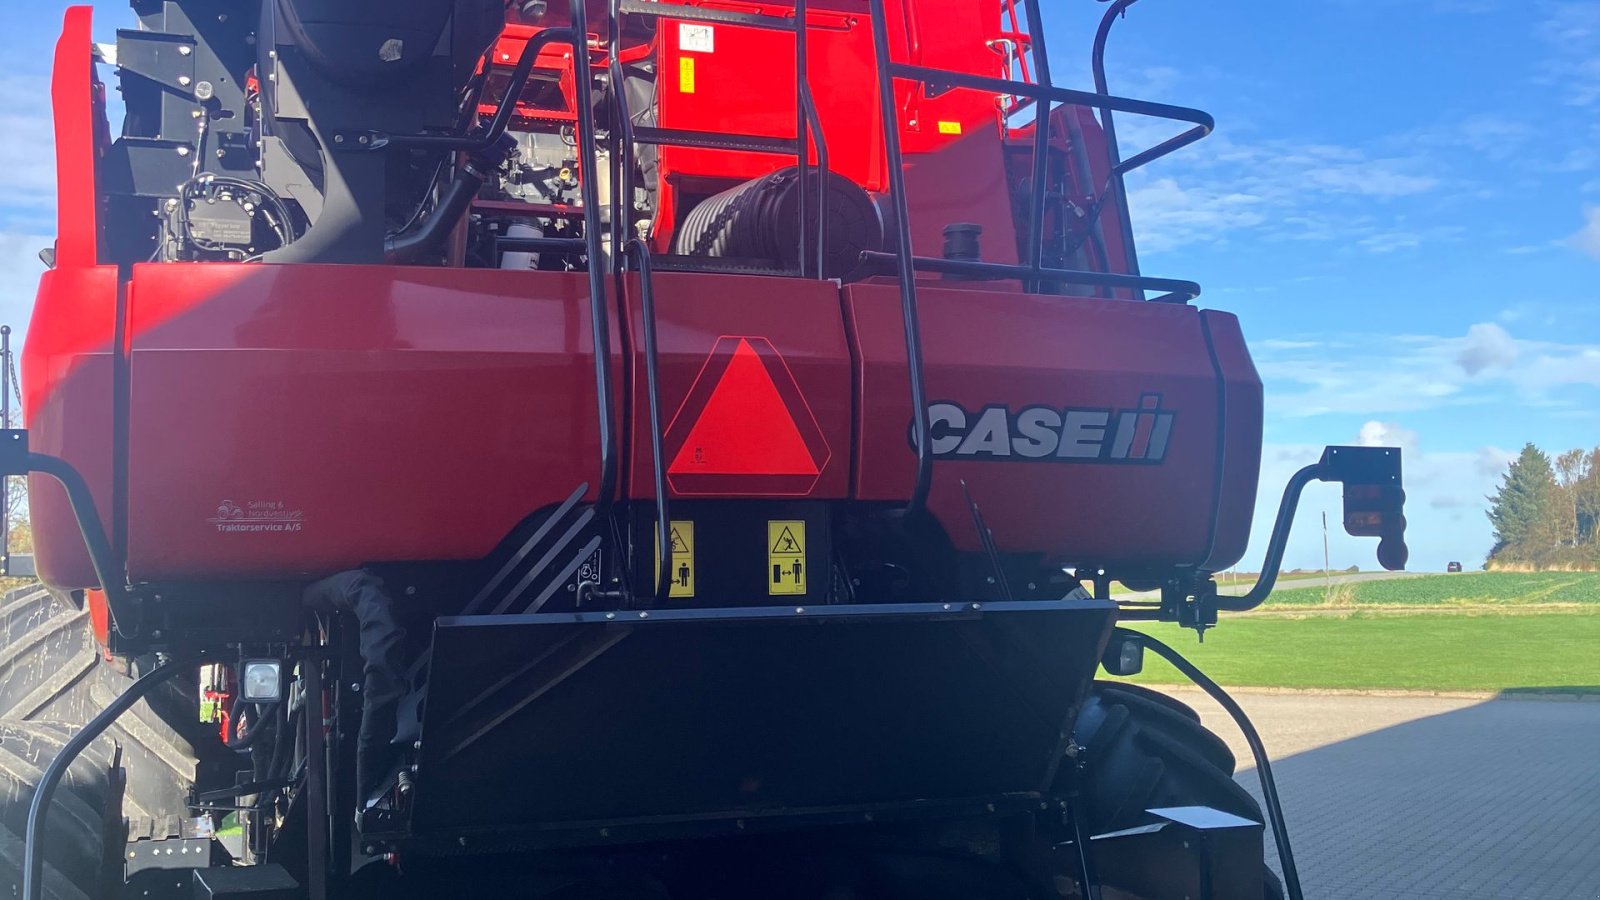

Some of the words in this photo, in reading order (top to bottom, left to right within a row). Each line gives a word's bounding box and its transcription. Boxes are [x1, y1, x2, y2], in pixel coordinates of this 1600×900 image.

[911, 403, 1109, 458] CASE
[217, 523, 283, 532] Traktorservice
[285, 523, 302, 532] A/S
